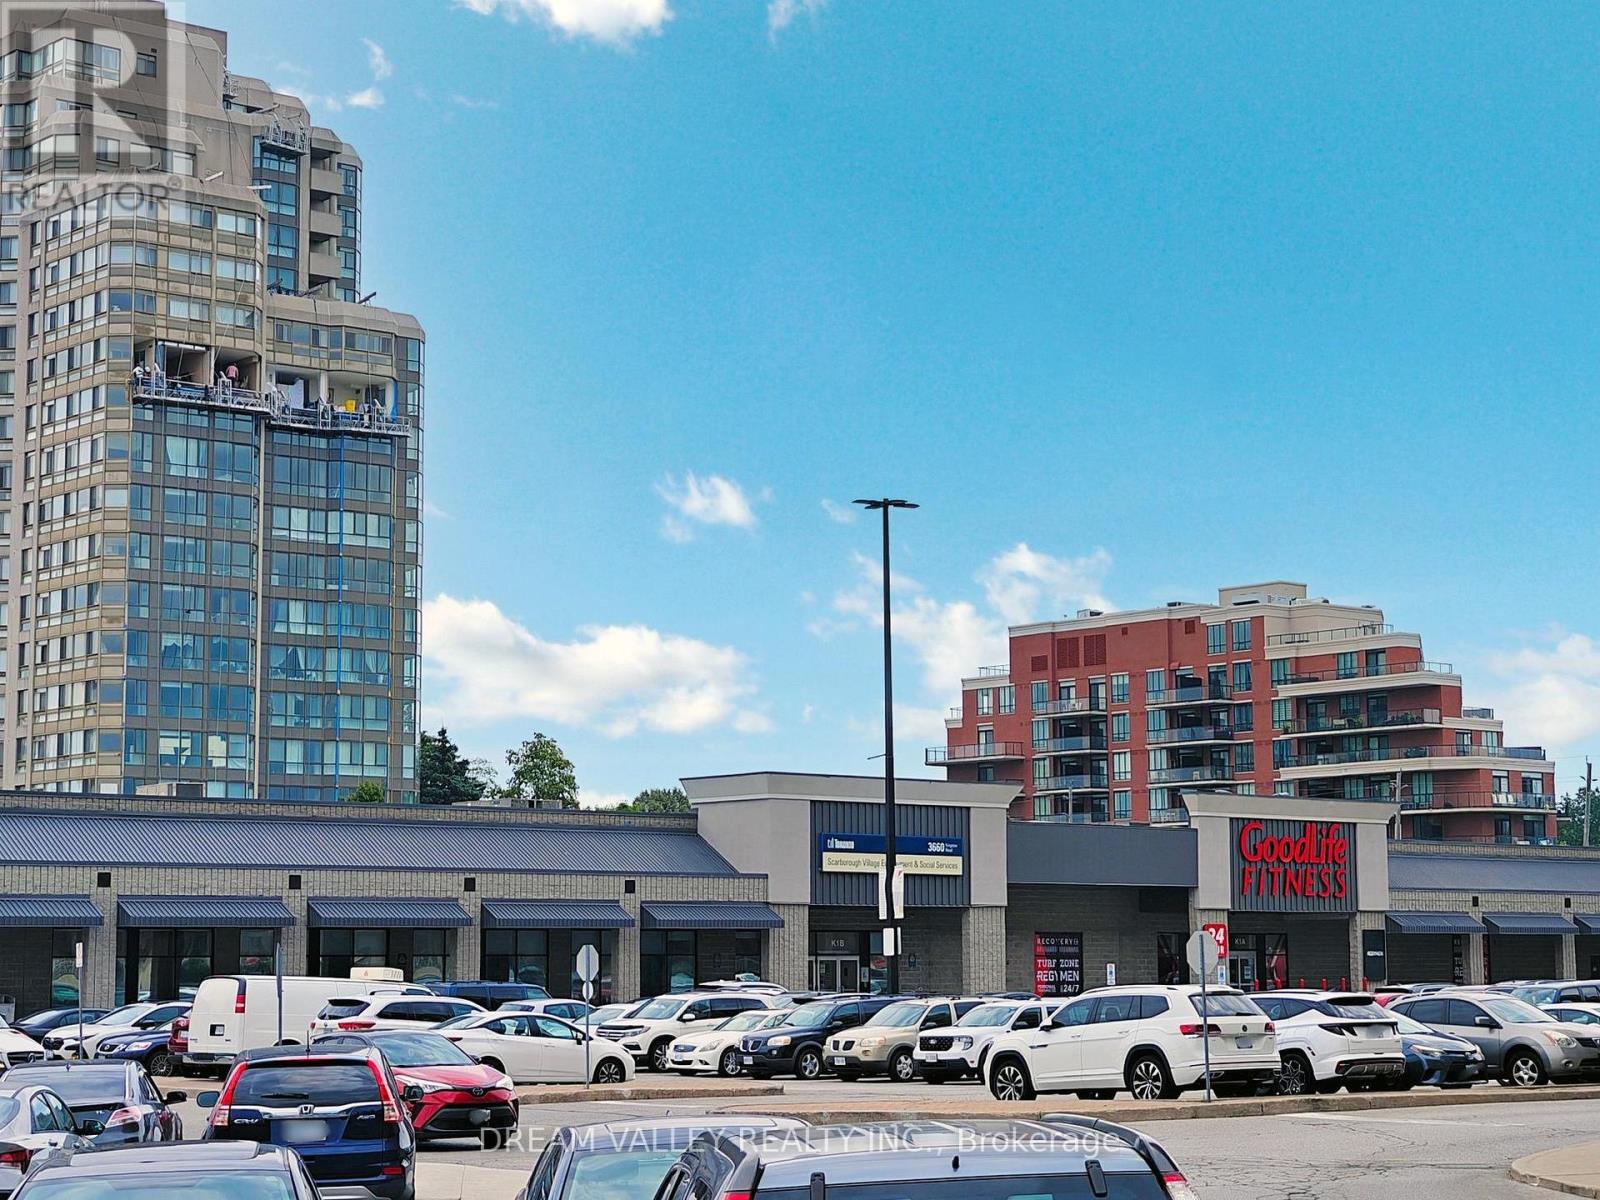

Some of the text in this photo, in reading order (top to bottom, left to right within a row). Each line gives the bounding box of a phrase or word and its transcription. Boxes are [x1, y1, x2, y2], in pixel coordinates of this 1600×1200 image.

[928, 841, 945, 853] 3660
[1240, 820, 1348, 864] GoodLife
[828, 857, 862, 869] Scarborough
[863, 858, 880, 869] Village
[914, 860, 919, 869] &
[919, 860, 936, 869] Social
[936, 860, 959, 870] Services
[1242, 865, 1348, 898] FITNESS
[1036, 959, 1080, 968] TURF ZONE
[1064, 984, 1080, 992] 24/7
